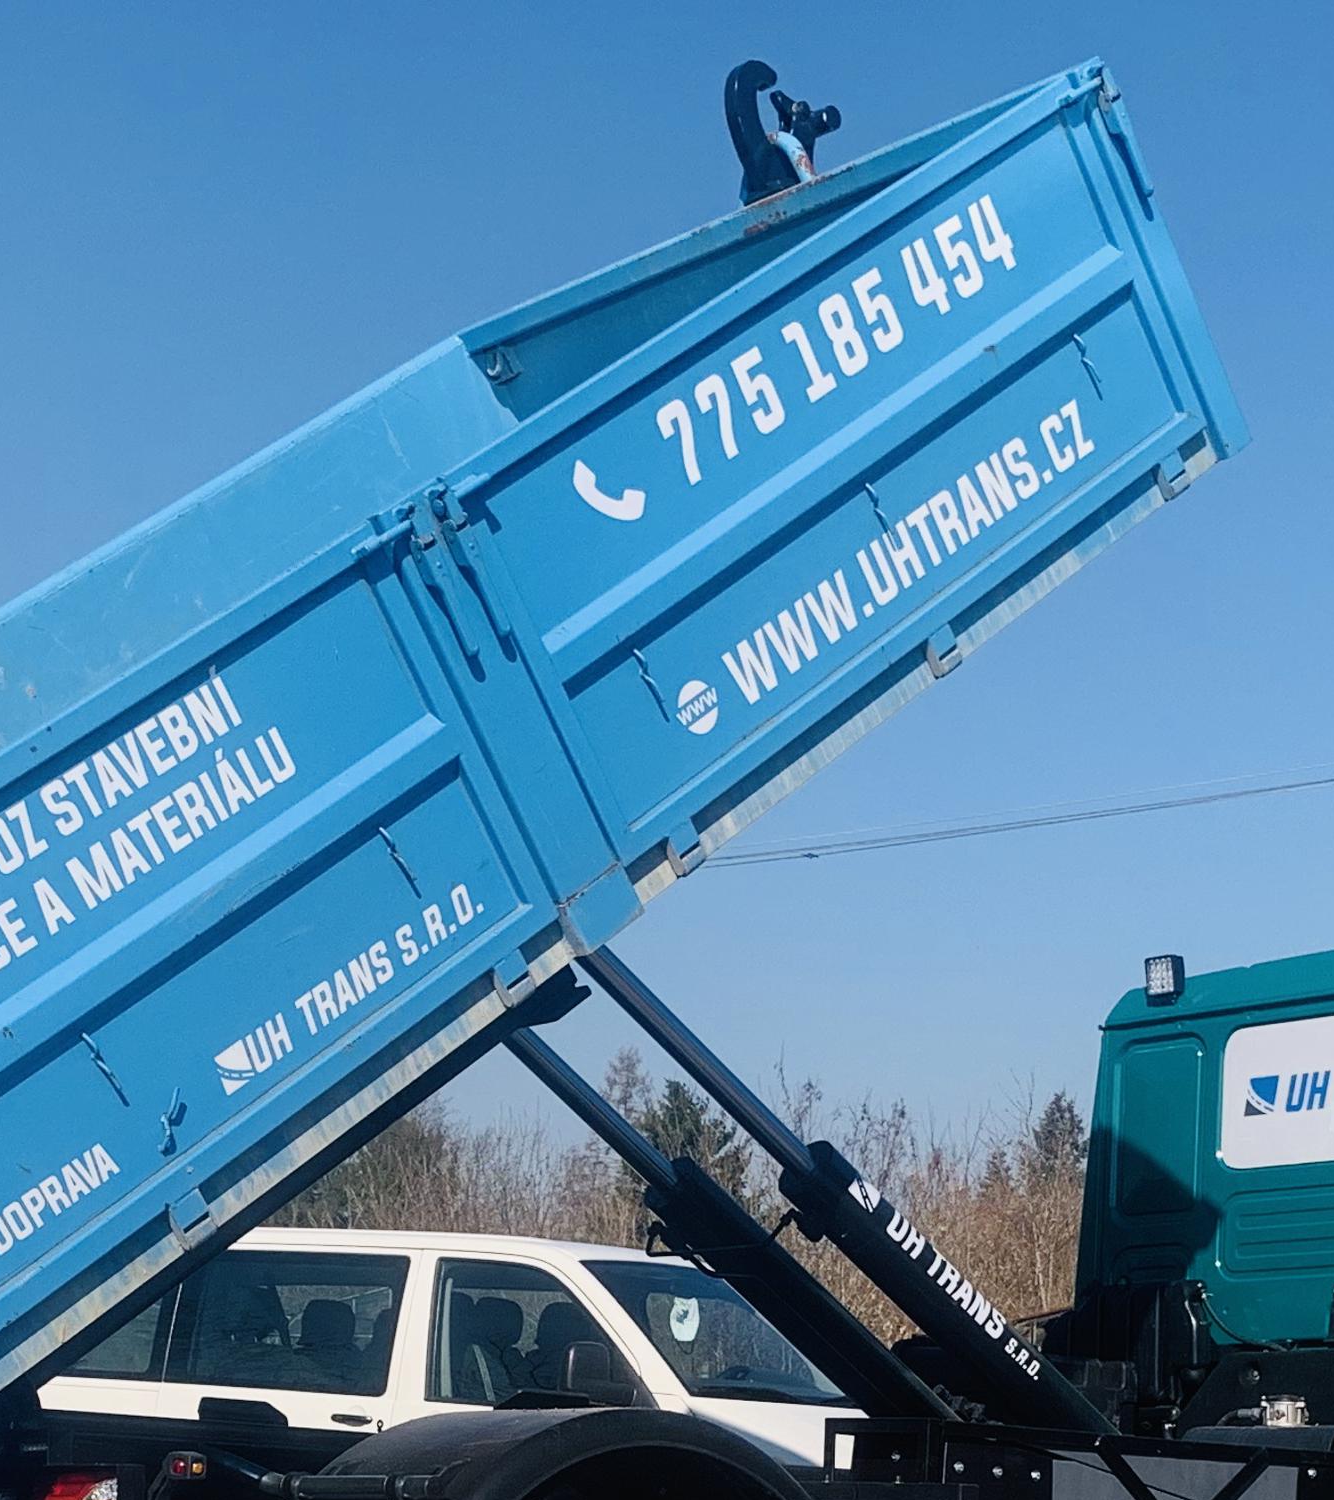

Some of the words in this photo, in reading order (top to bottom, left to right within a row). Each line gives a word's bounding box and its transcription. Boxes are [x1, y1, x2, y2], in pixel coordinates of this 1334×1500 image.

[657, 347, 784, 485] 775
[781, 267, 903, 402] 185
[901, 194, 1016, 314] 454
[721, 399, 1094, 704] WWW.UHTRANS.CZ
[33, 879, 76, 935] A
[65, 727, 296, 910] MATERIÁLU
[40, 665, 243, 837] STAVEBNÍ
[245, 1013, 293, 1073] UH
[294, 940, 394, 1035] TRANS
[395, 884, 484, 966] S.R.O.
[1285, 1070, 1331, 1113] UH
[885, 1211, 925, 1260] UH
[927, 1247, 1007, 1340] TRANS
[1004, 1337, 1039, 1381] S.R.O.
